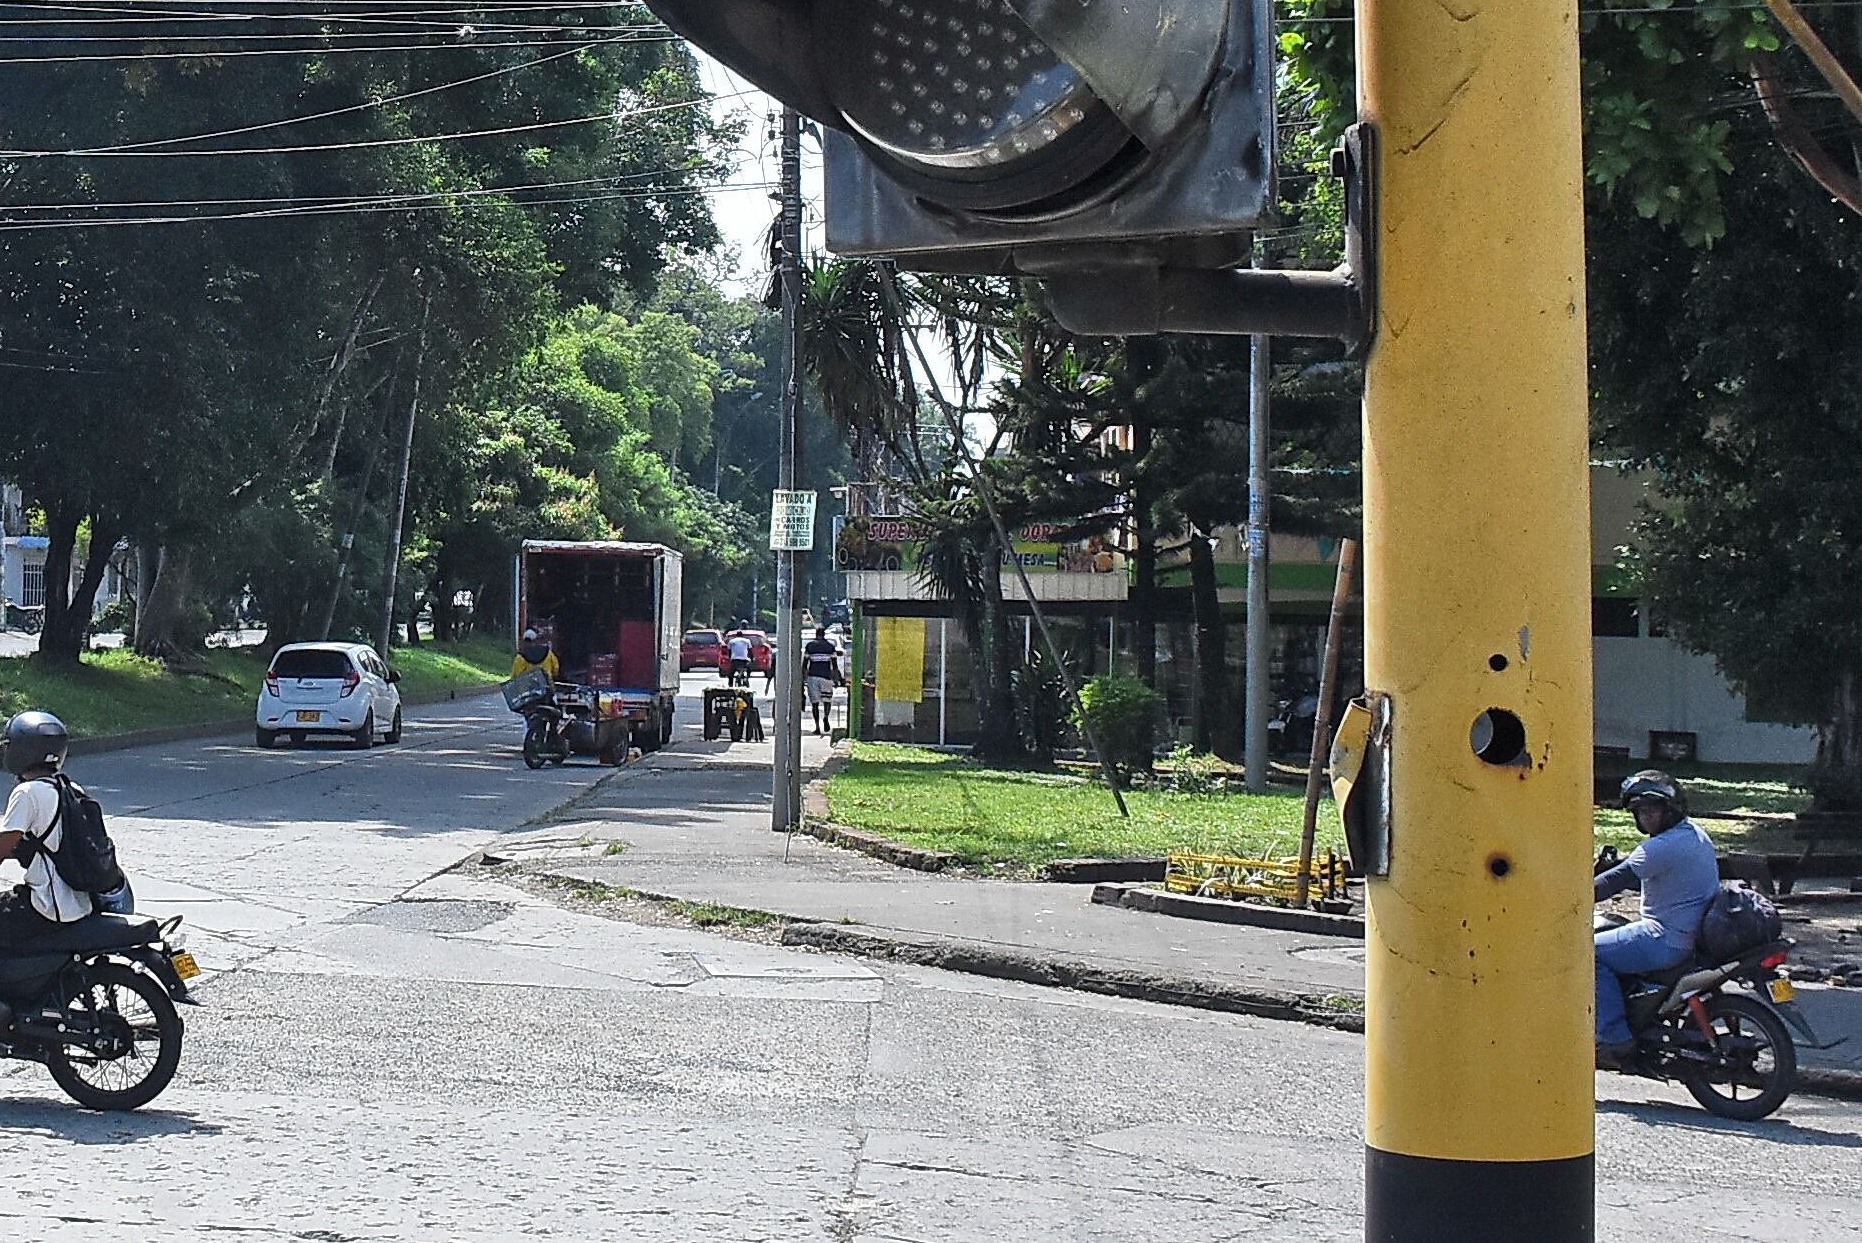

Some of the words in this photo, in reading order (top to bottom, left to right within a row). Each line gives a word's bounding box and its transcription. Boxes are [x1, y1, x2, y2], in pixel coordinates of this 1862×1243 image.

[775, 493, 805, 504] LAVADO
[781, 516, 810, 524] CARROS
[783, 523, 810, 531] MOTOS
